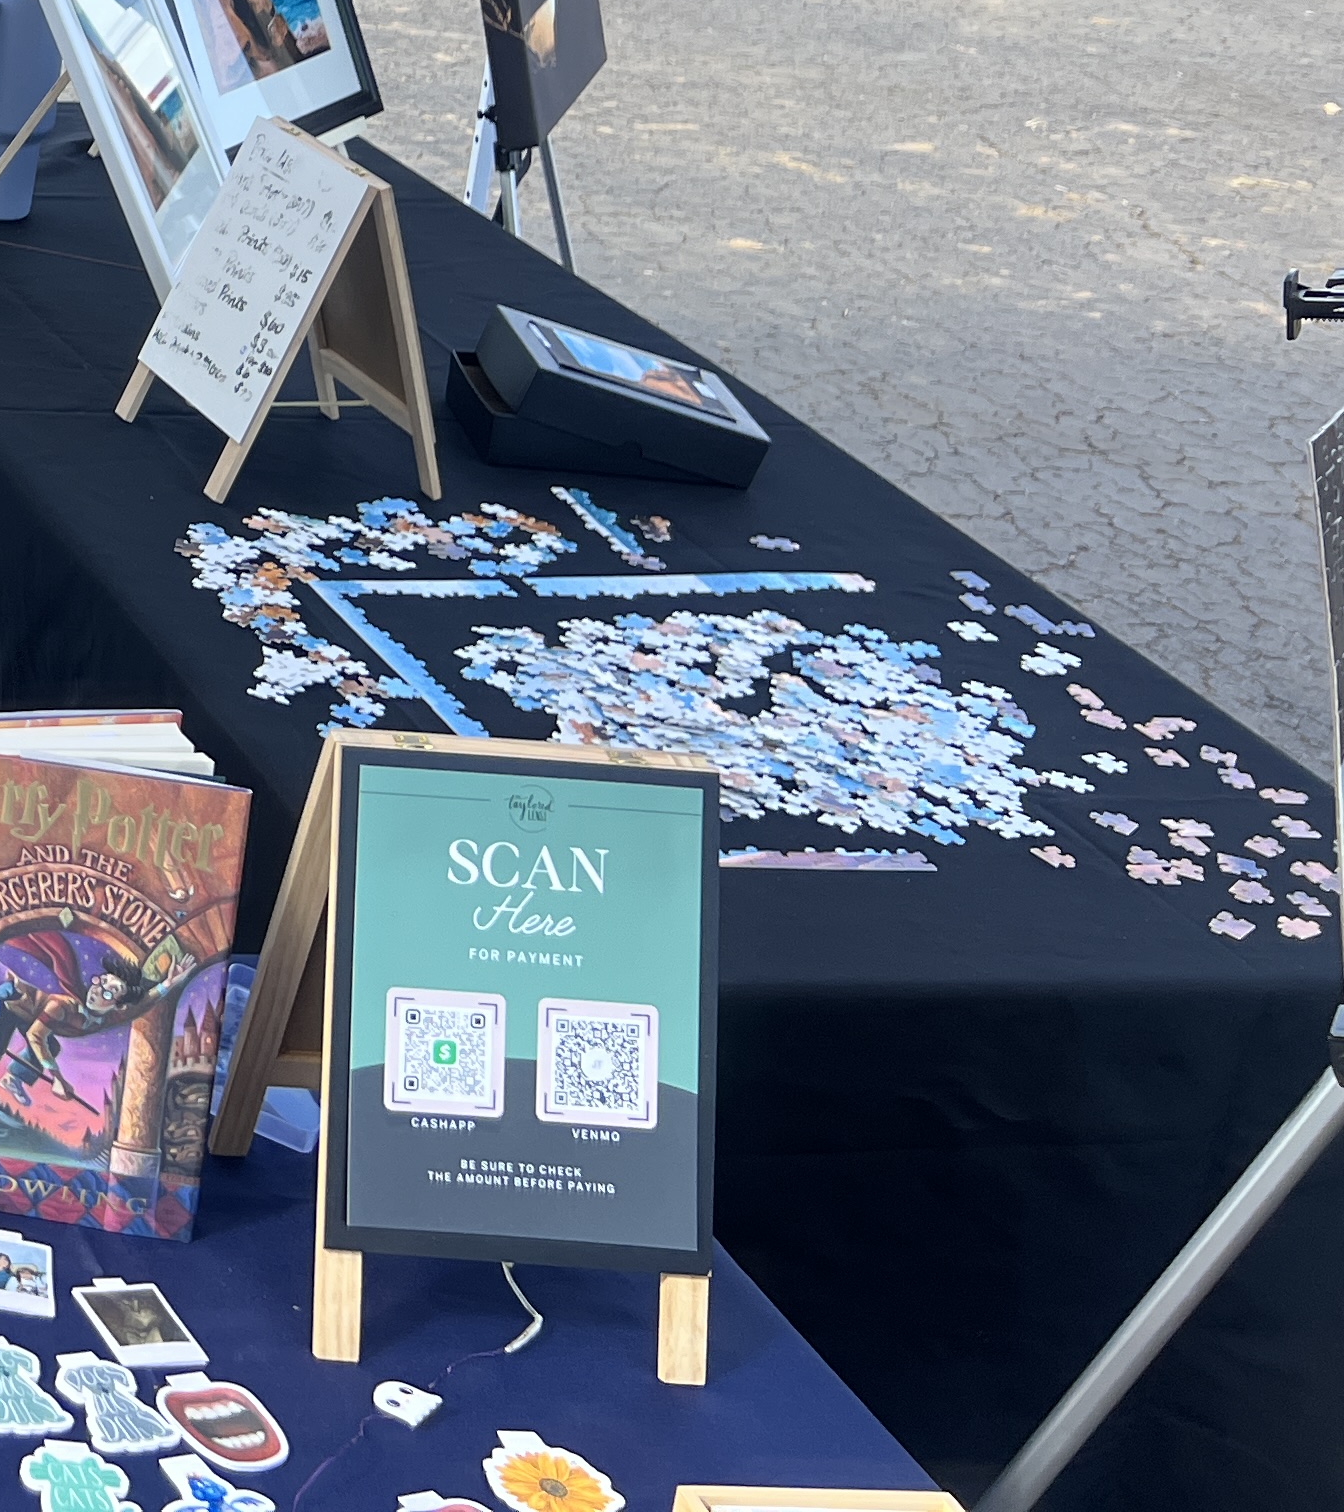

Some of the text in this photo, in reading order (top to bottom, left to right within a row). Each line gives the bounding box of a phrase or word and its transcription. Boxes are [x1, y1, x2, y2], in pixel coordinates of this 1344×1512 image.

[71, 778, 226, 874] Potter
[15, 844, 134, 882] AND THE
[447, 838, 610, 894] SCAN
[101, 883, 172, 947] STONE
[472, 890, 577, 937] Here
[468, 947, 584, 968] FOR PAYMENT
[410, 1116, 476, 1132] CASHAPP
[571, 1127, 621, 1143] VENMO
[460, 1158, 583, 1178] BE SURE TO CHECK
[427, 1169, 617, 1195] THE AMOUNT BEFORE PAYING
[64, 1366, 130, 1393] DOGS
[47, 1462, 103, 1486] CATS
[54, 1485, 111, 1511] CATS
